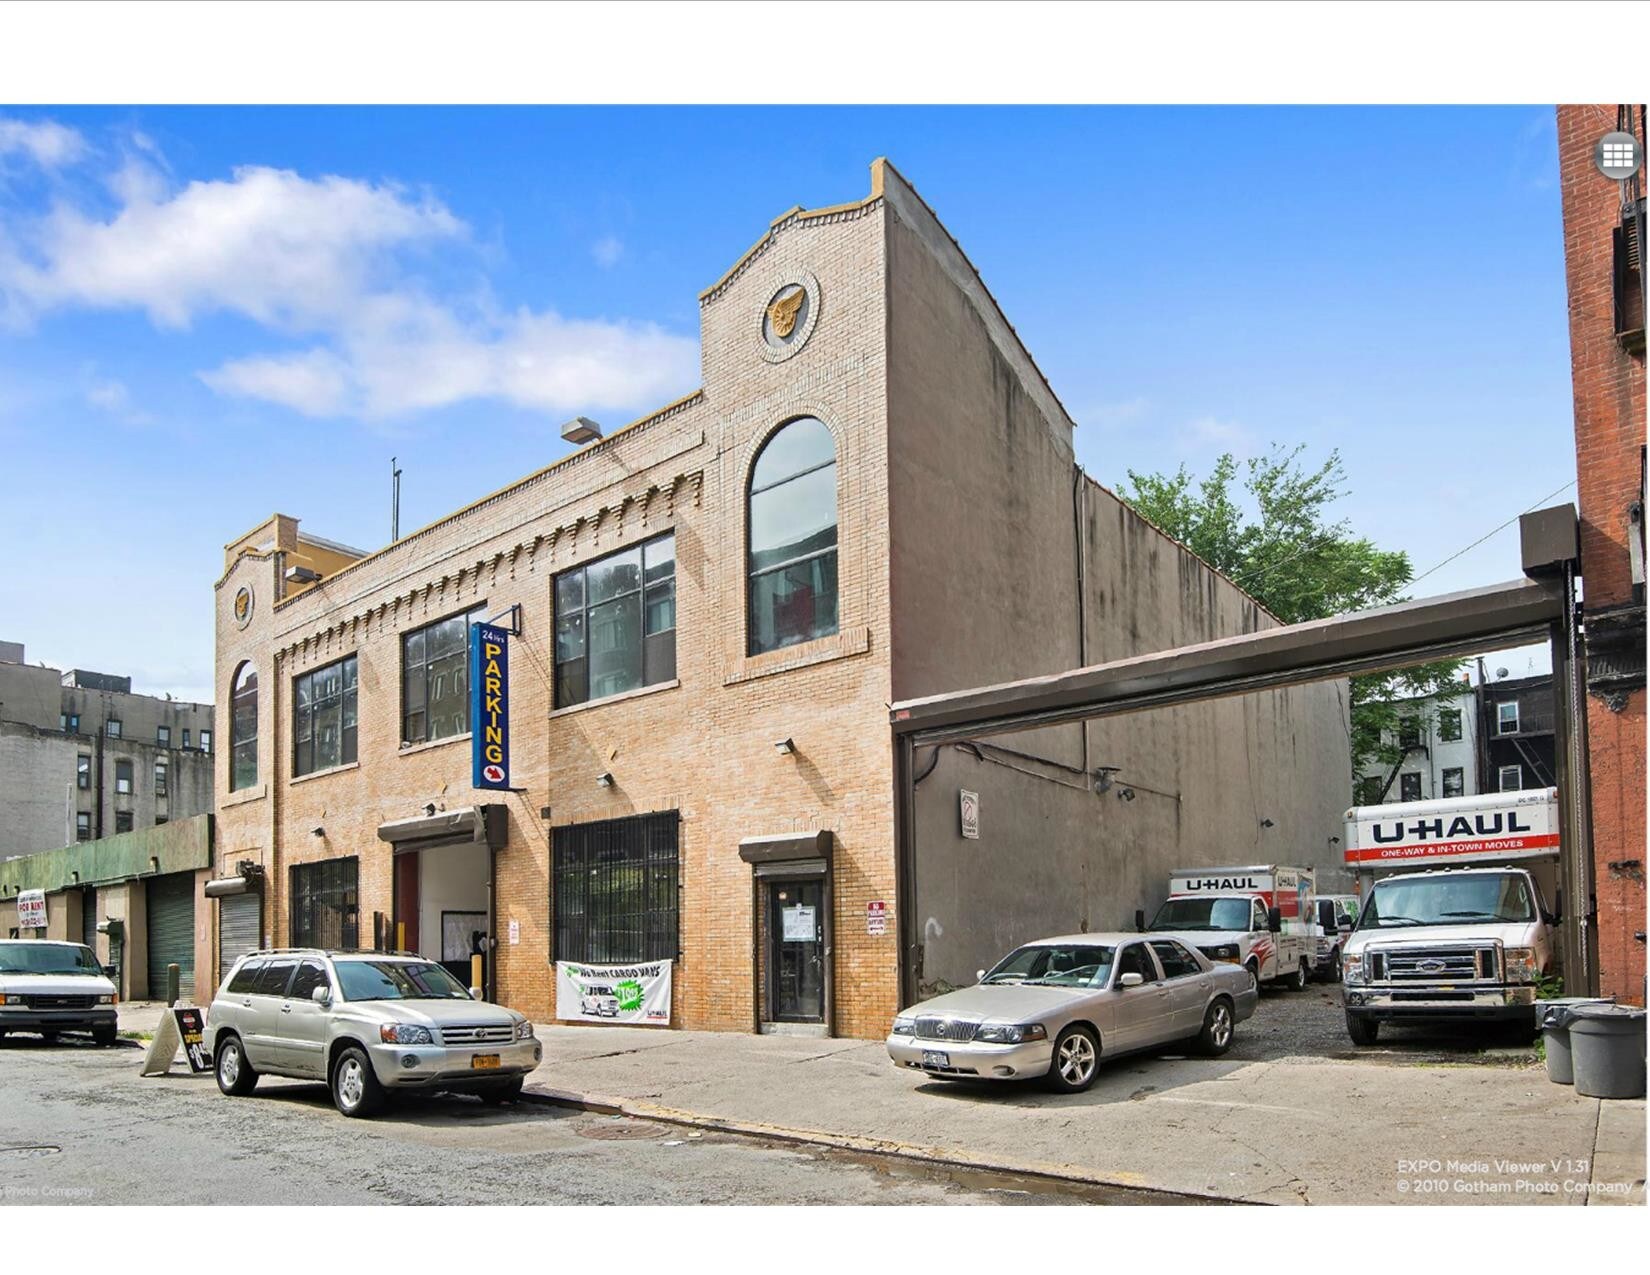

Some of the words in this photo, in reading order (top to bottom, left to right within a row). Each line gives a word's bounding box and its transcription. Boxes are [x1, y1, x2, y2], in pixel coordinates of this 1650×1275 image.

[482, 630, 493, 641] 24
[485, 643, 503, 764] PARKING
[1372, 811, 1531, 844] U-HAUL
[1381, 847, 1425, 857] ONE-WAY
[1427, 846, 1435, 854] &
[1437, 843, 1483, 853] IN-TOWN
[1485, 839, 1524, 849] MOVES
[1186, 877, 1258, 891] U-HAUL
[18, 903, 29, 911] FOR
[579, 967, 591, 978] We
[590, 969, 610, 978] Rent
[609, 969, 639, 978] CARGO
[638, 966, 661, 978] VANS
